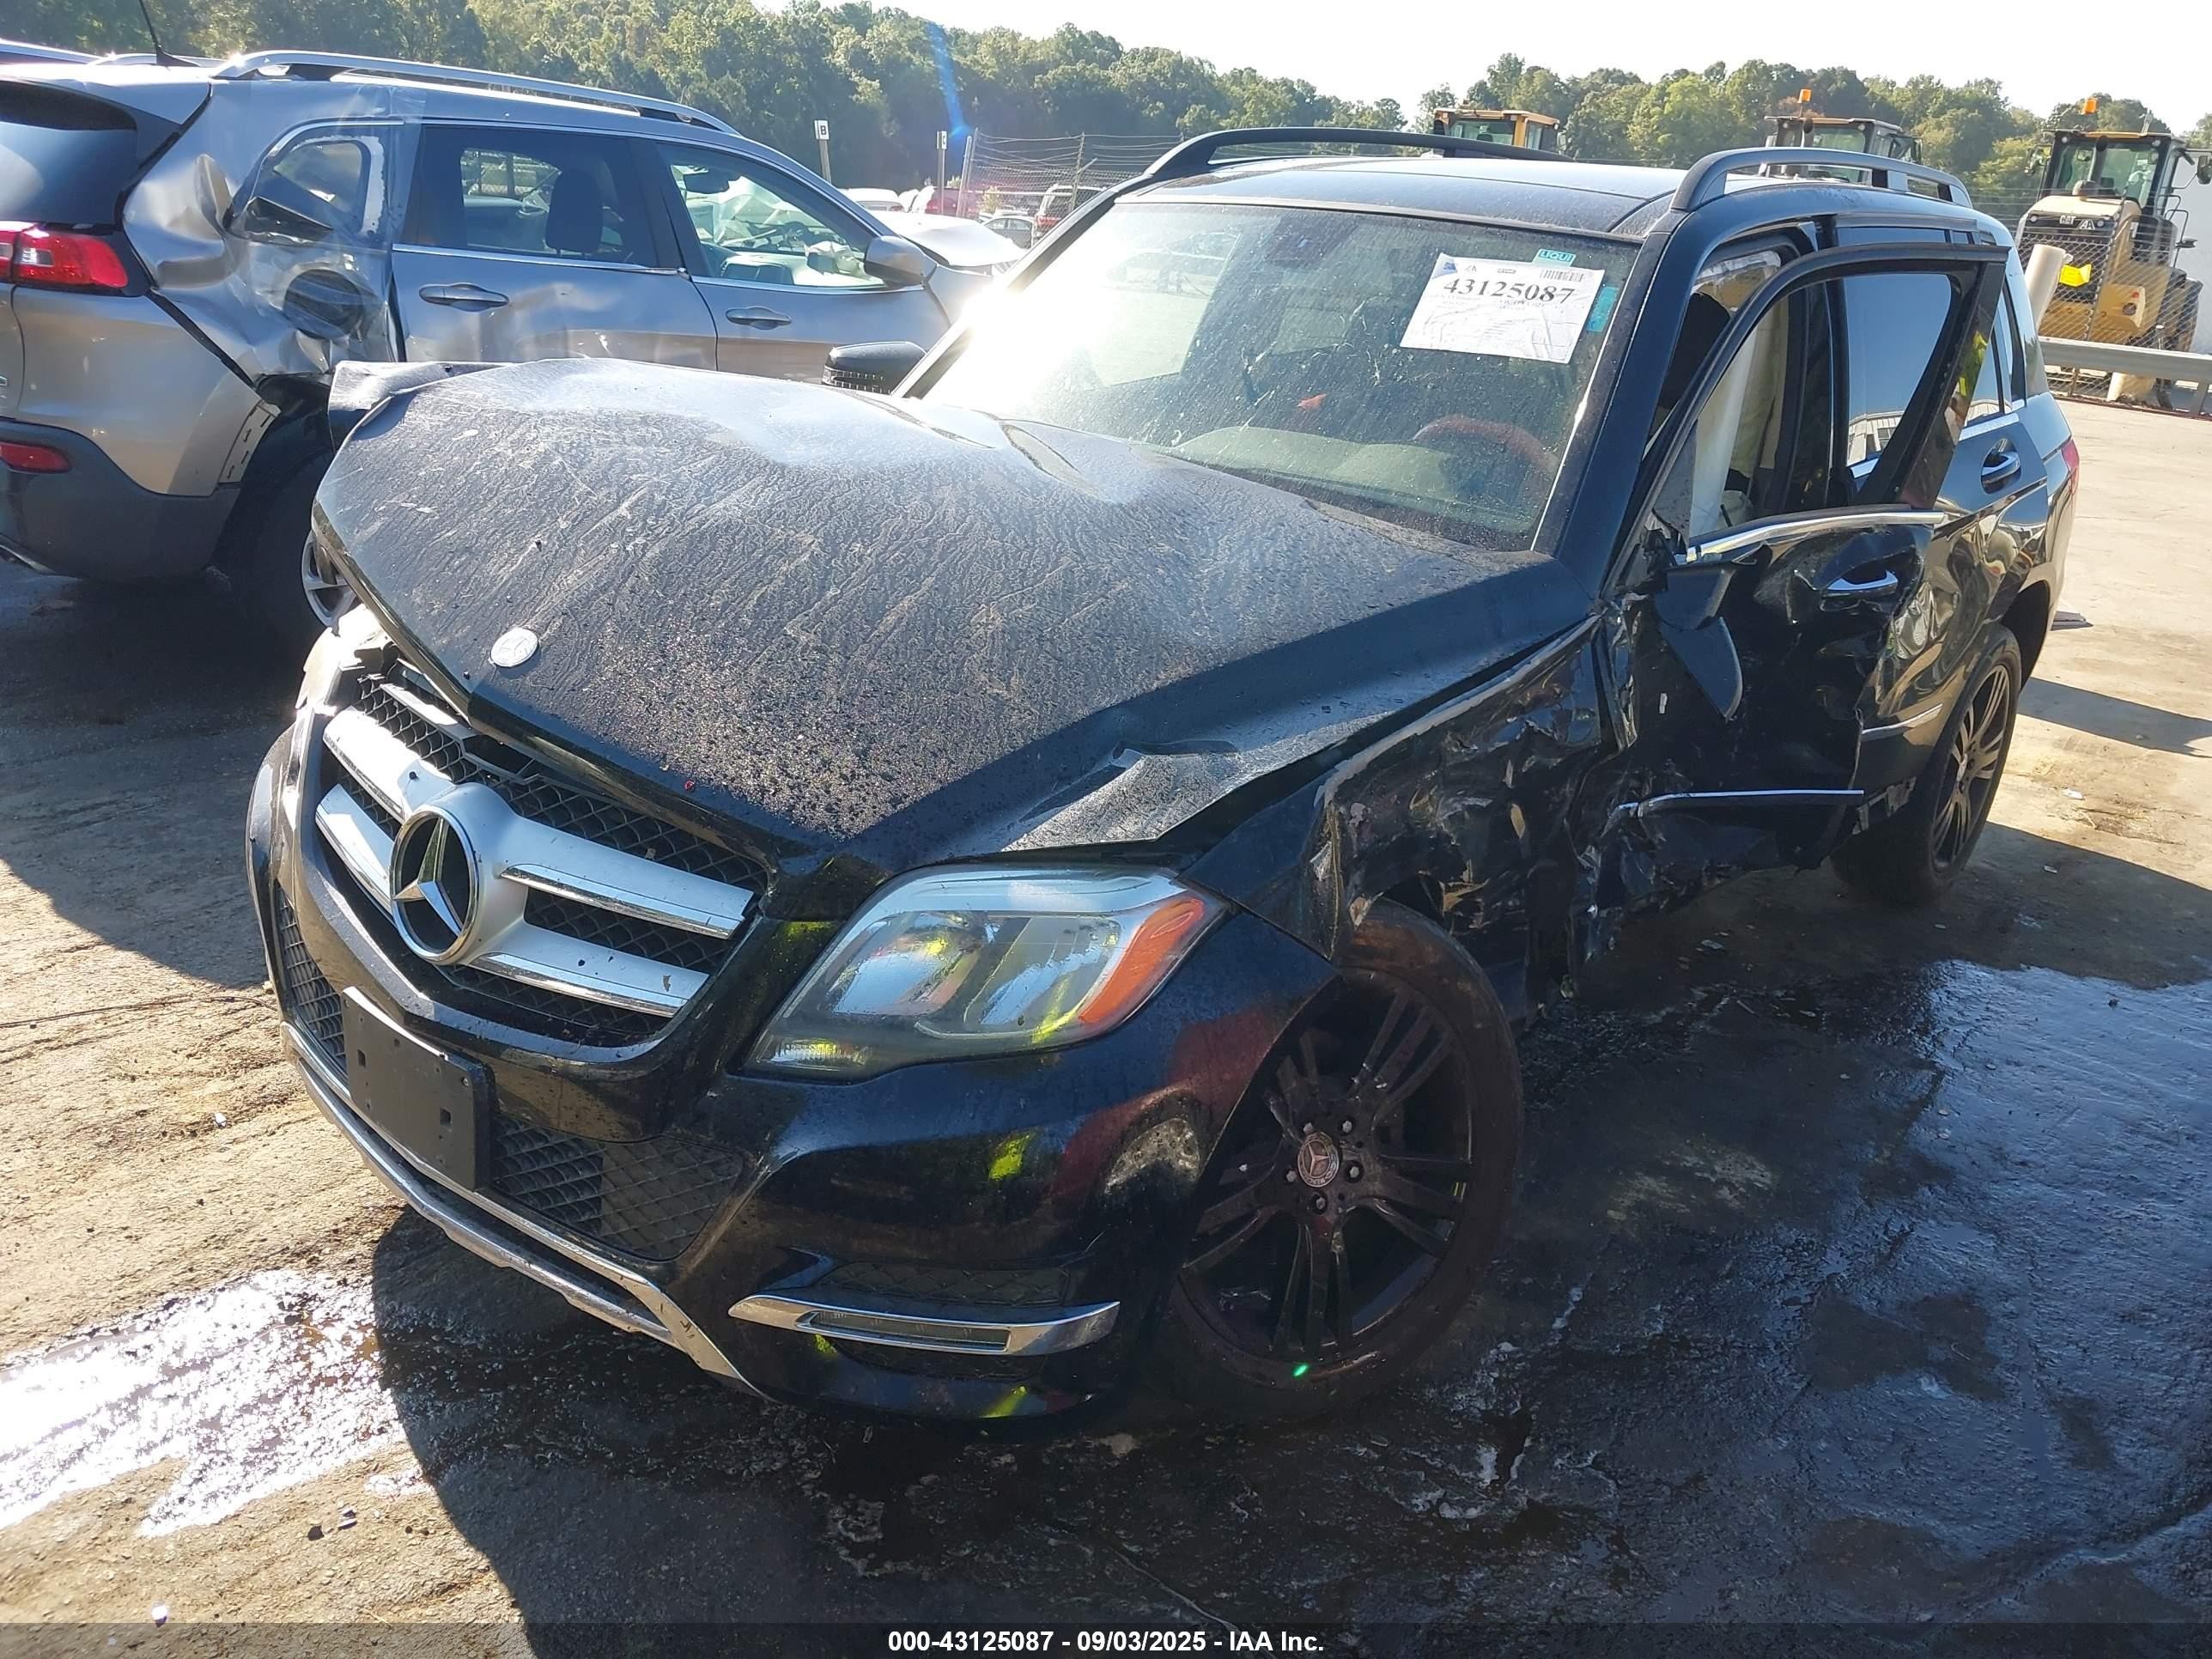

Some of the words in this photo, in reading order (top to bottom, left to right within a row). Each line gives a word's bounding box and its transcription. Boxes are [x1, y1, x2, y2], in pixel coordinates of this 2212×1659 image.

[820, 125, 827, 135] B
[2059, 215, 2076, 224] CAT
[1538, 249, 1573, 262] LIQUI
[1443, 277, 1576, 304] 43125087
